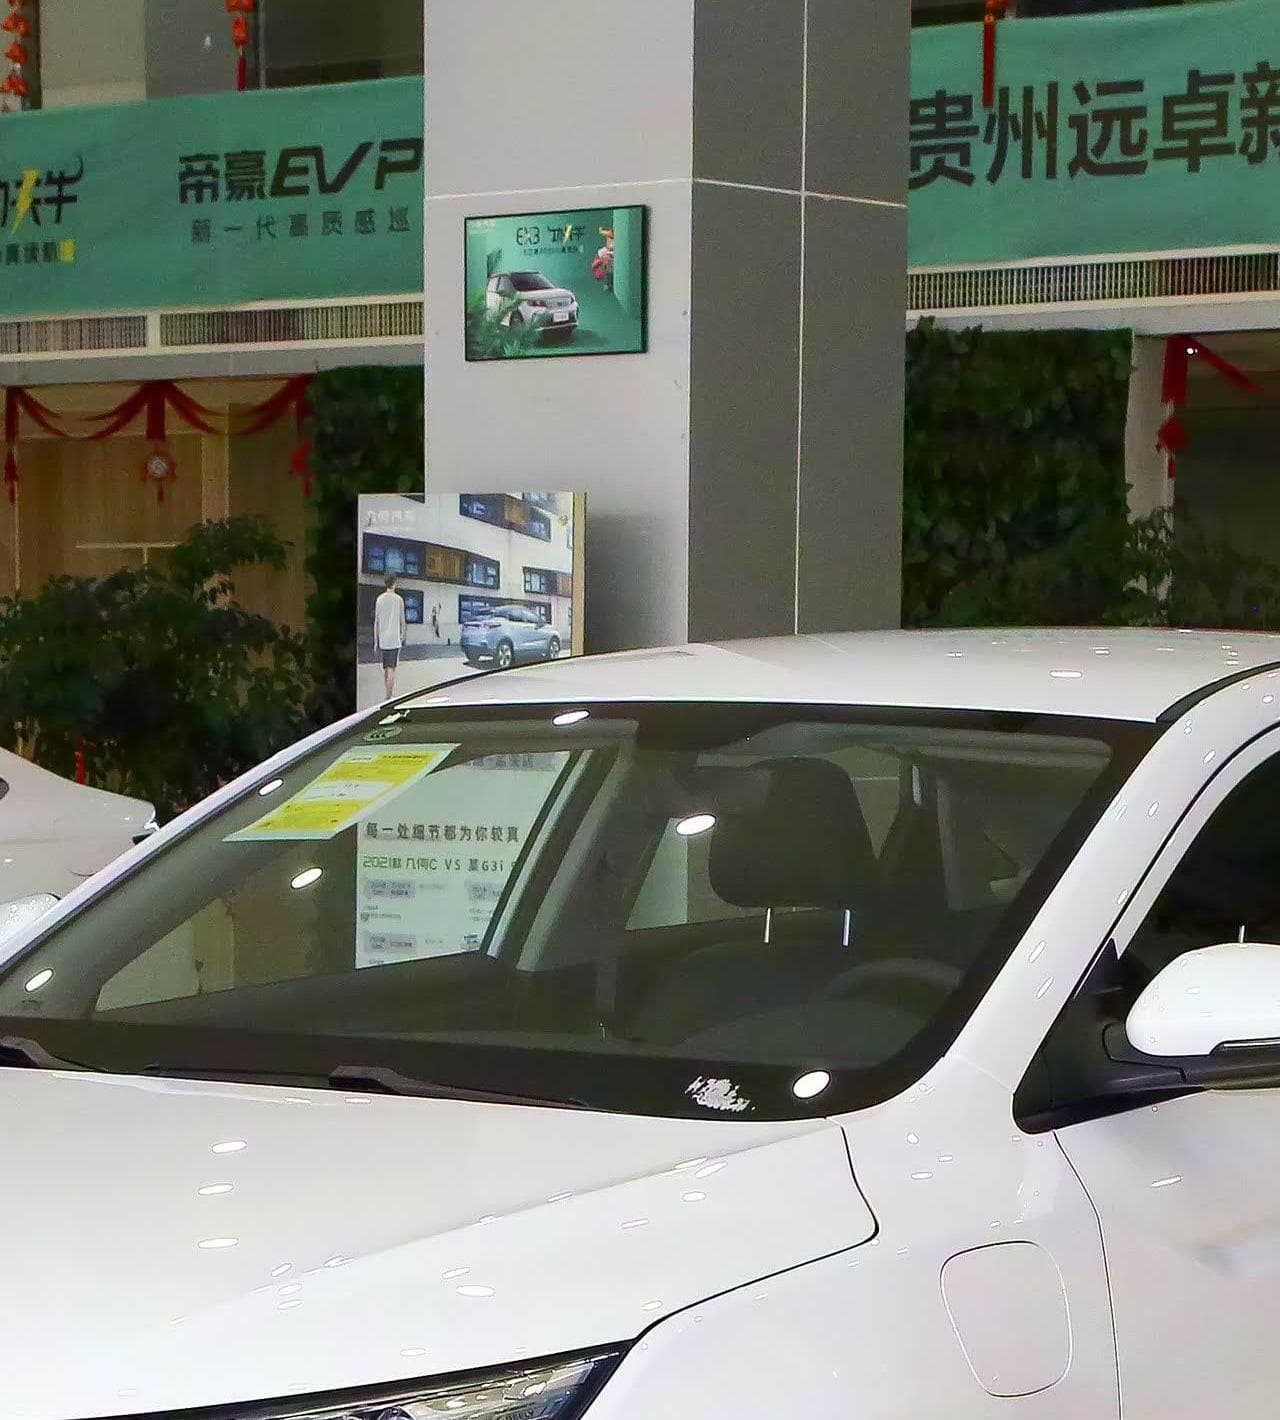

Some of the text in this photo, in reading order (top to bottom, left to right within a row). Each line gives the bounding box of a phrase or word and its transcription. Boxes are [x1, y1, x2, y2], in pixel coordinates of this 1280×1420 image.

[366, 822, 520, 843] 每一处细节都为你较真
[444, 859, 461, 871] VS
